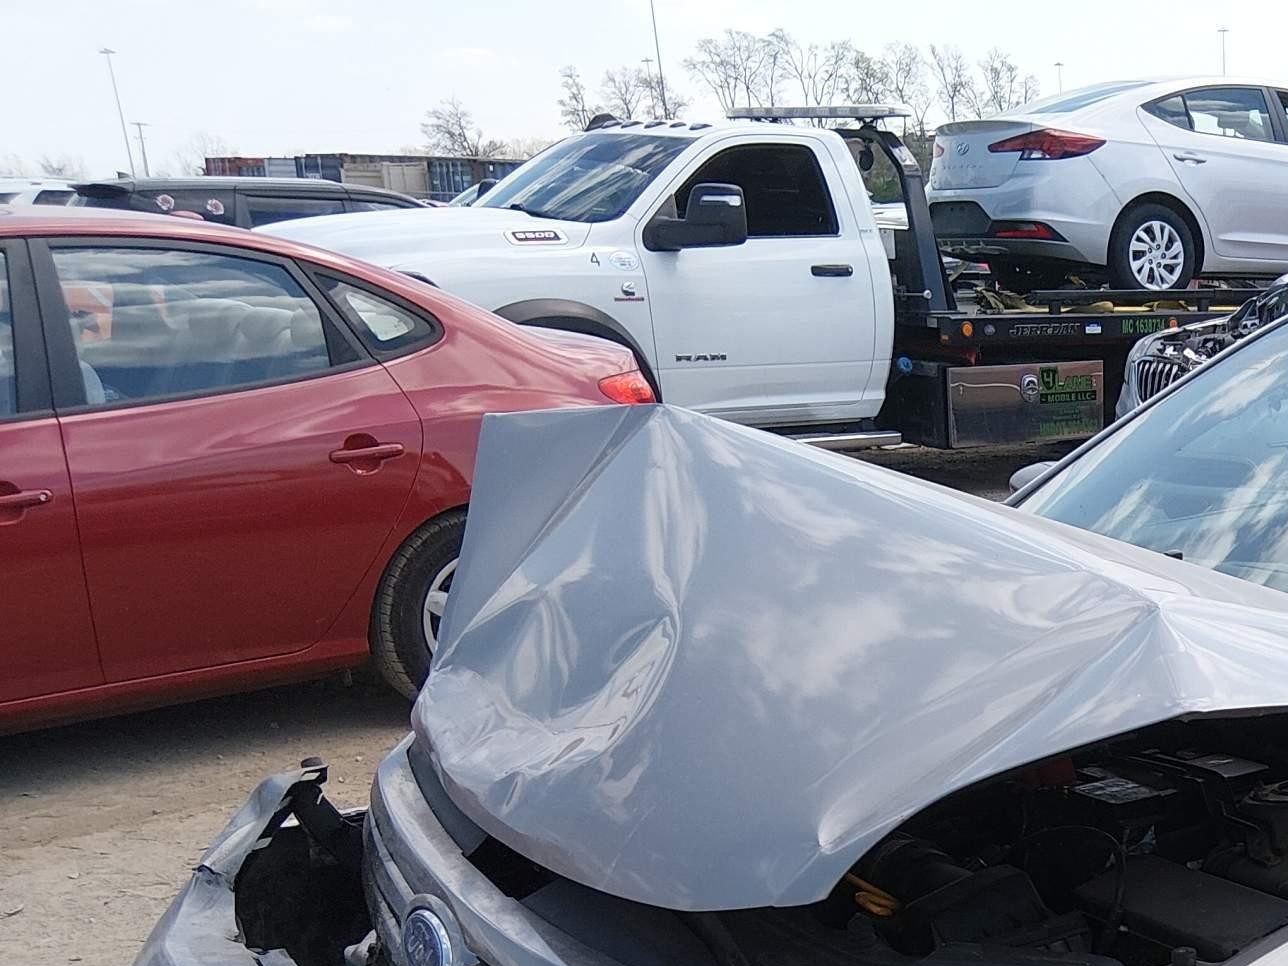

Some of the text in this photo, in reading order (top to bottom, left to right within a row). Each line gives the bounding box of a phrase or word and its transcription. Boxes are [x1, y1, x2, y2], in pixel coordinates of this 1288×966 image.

[675, 353, 728, 362] RAM
[1047, 392, 1091, 402] MOBILE LLC
